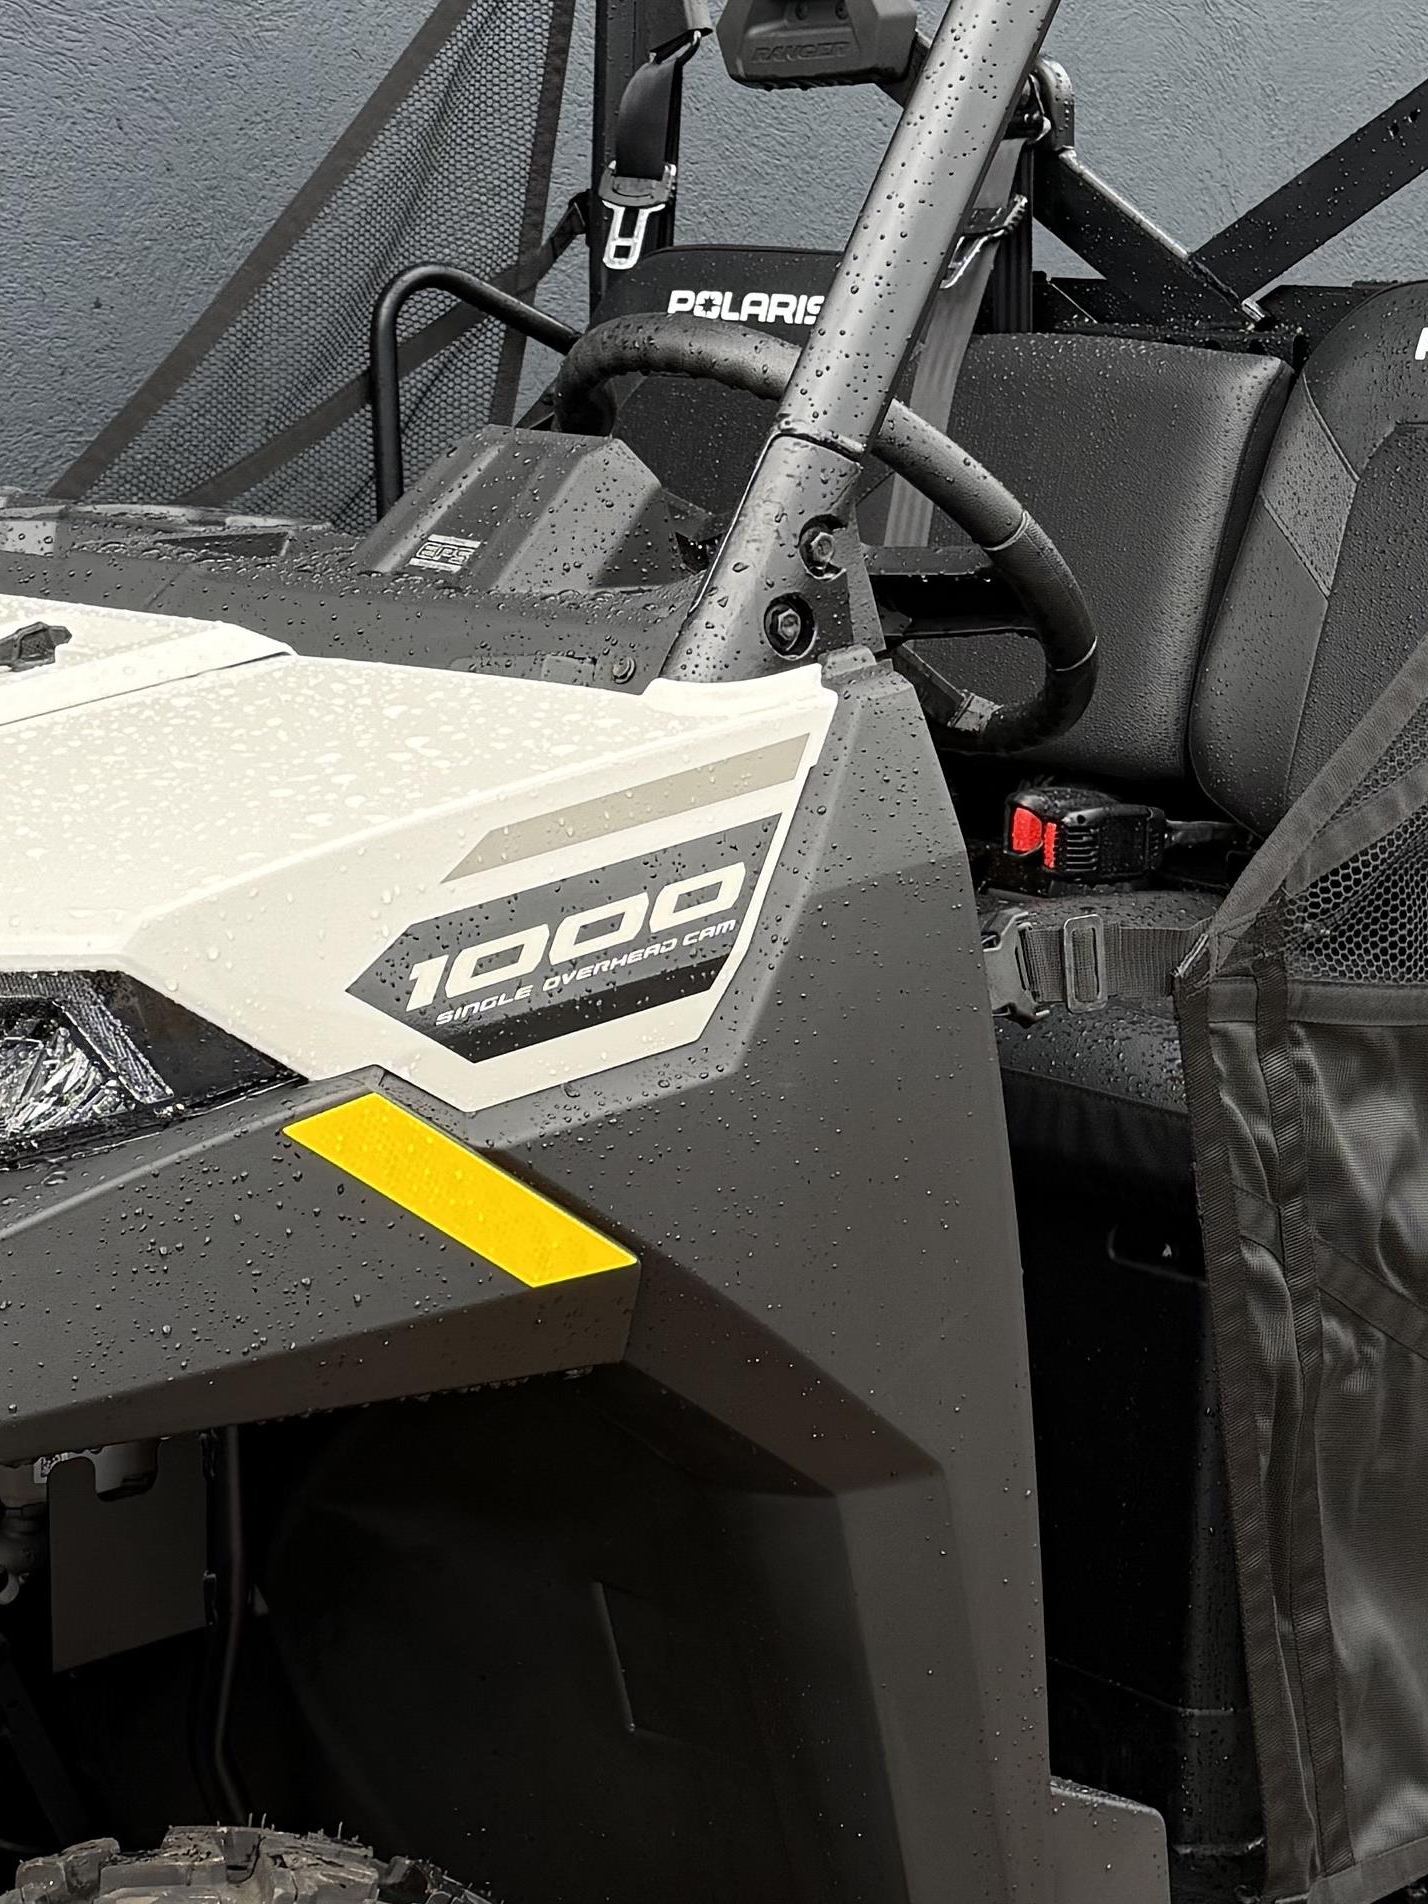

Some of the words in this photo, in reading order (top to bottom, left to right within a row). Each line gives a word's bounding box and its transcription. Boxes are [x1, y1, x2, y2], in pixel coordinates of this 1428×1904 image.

[406, 861, 747, 1012] 1000
[435, 986, 533, 1026] SINGLE
[542, 937, 678, 992] OVERHEAD
[682, 919, 737, 946] CAM
